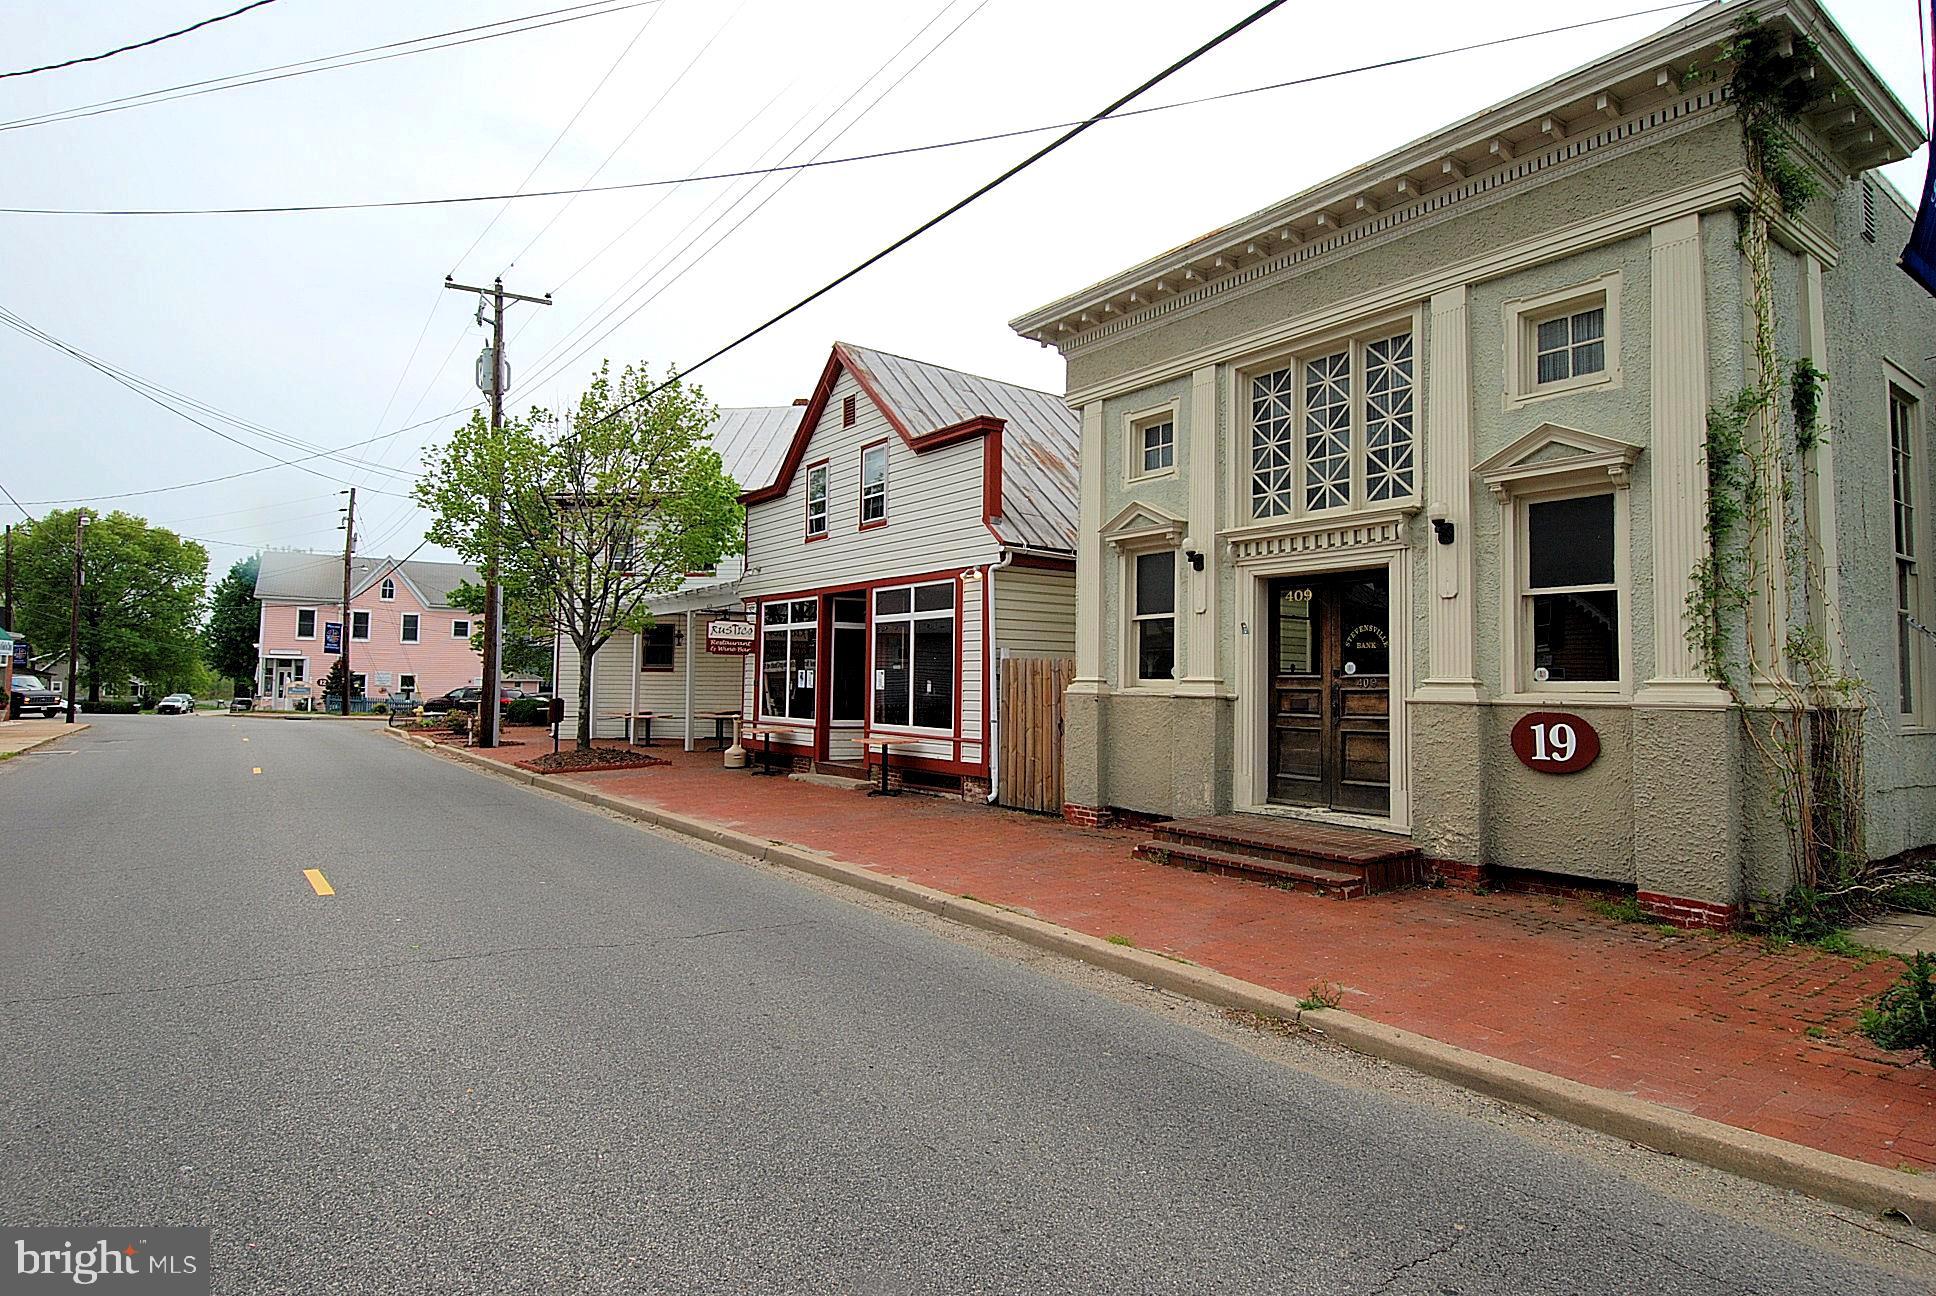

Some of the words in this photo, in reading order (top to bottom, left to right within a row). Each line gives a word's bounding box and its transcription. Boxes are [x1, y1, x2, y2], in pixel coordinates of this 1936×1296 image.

[1285, 589, 1313, 602] 409
[1345, 624, 1389, 648] STEVENSVILLE
[710, 639, 752, 647] Restaurant
[1356, 678, 1377, 688] 409
[1530, 723, 1577, 762] 19
